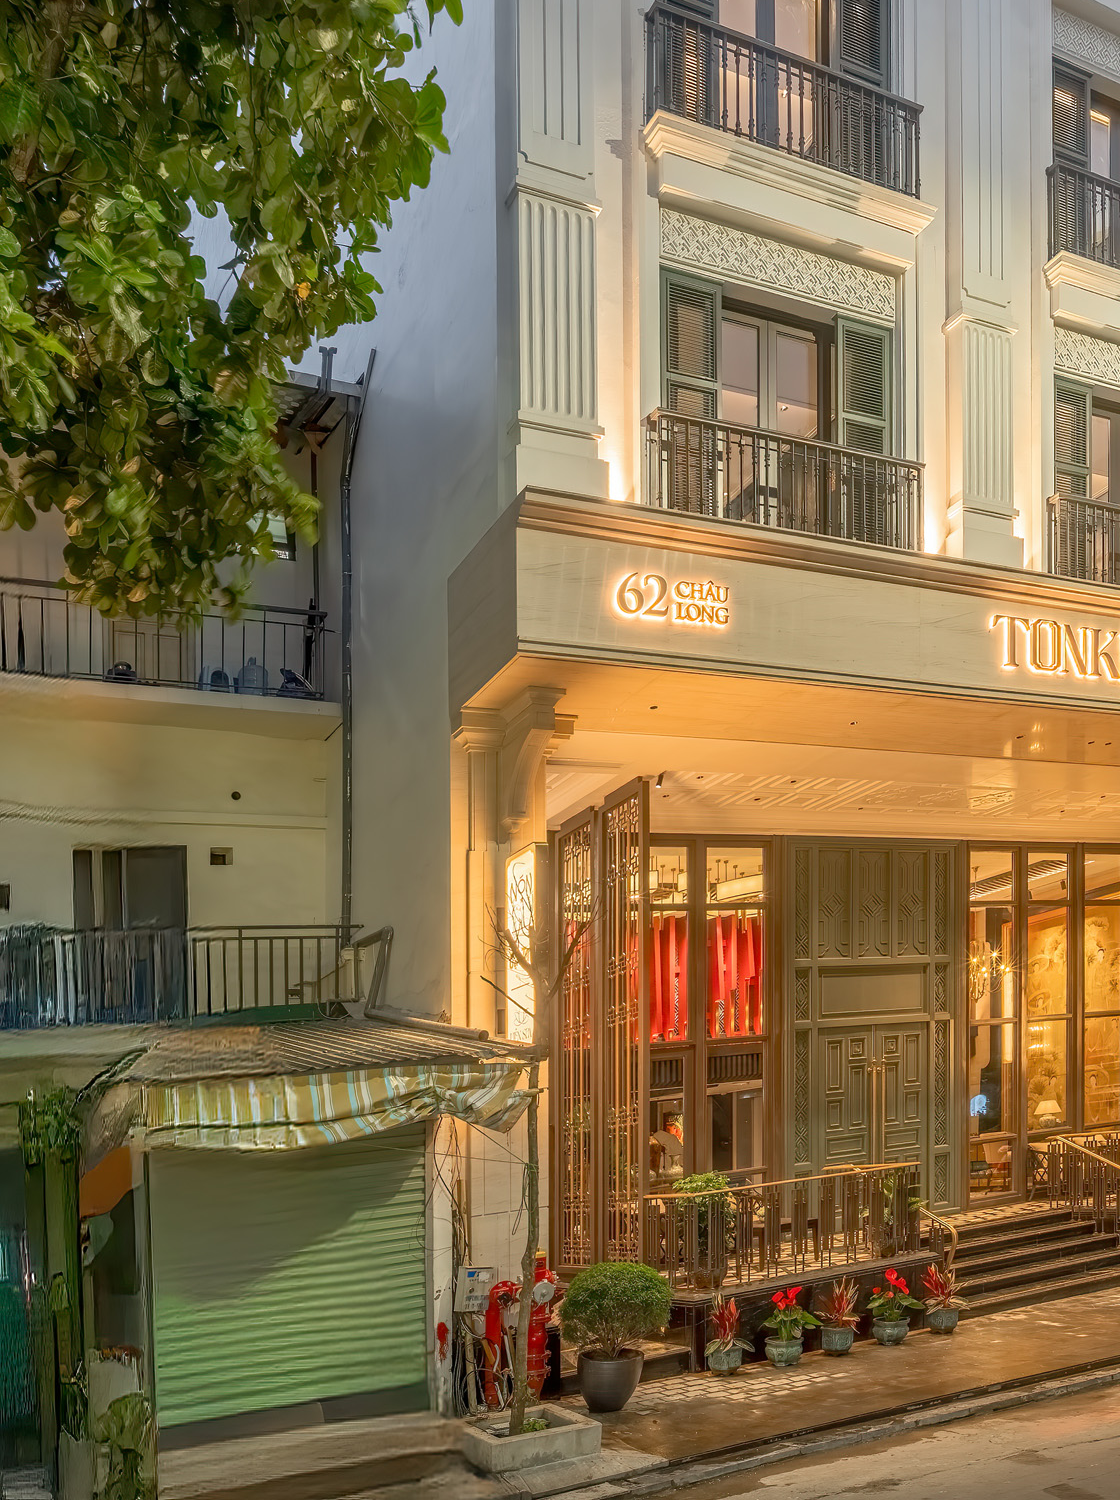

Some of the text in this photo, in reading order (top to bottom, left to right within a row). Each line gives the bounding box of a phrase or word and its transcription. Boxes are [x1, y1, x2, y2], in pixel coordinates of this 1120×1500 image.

[616, 572, 669, 617] 62
[674, 580, 729, 604] CHÂU
[674, 602, 729, 625] LONG
